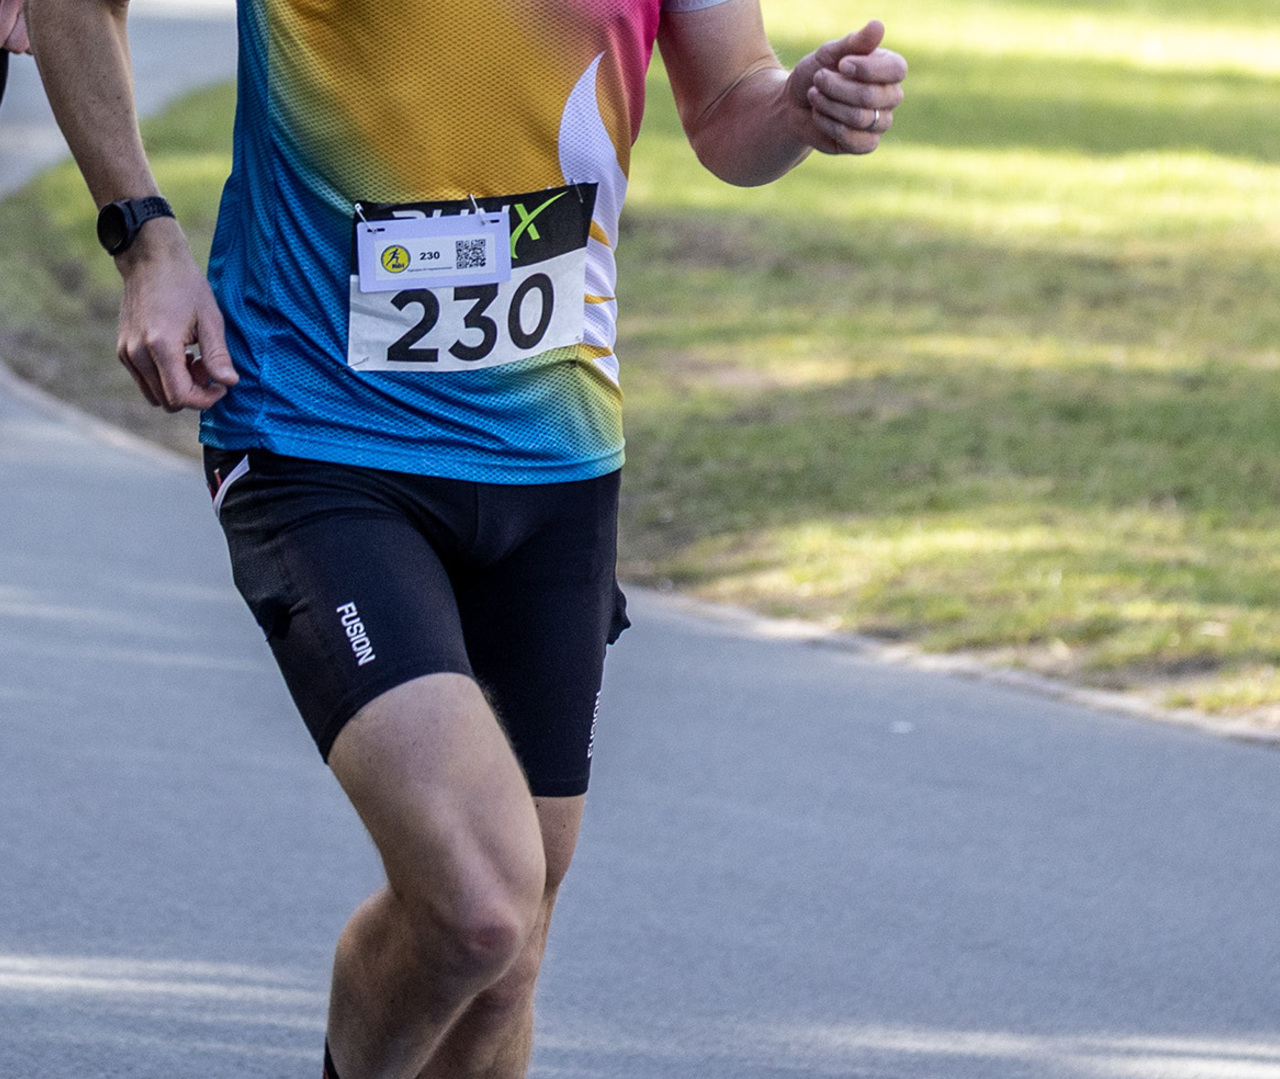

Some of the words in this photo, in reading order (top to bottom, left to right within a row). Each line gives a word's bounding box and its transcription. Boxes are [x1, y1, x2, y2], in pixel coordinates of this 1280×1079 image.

[419, 251, 440, 260] 230
[387, 272, 555, 363] 230
[336, 601, 376, 667] FUSION
